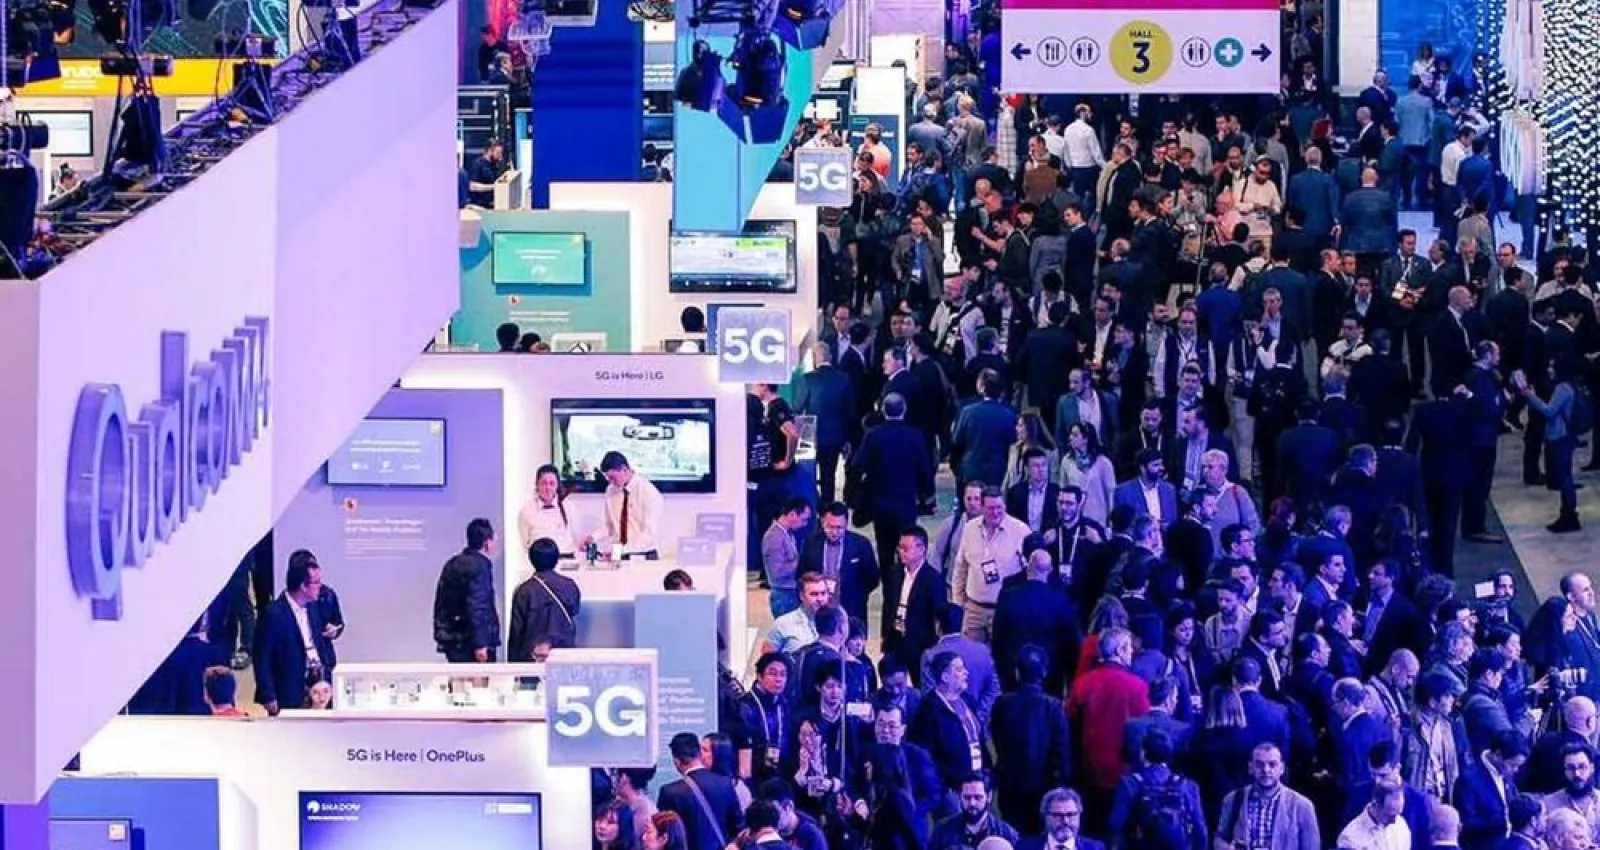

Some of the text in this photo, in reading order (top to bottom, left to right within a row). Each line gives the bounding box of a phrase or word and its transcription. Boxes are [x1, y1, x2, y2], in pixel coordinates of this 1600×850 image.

[1129, 30, 1153, 38] HALL
[1132, 42, 1151, 73] 3
[799, 162, 848, 191] 5G
[723, 327, 785, 364] 5G
[595, 370, 610, 380] 5G
[621, 371, 644, 380] Here
[649, 371, 664, 380] LG
[65, 314, 270, 621] Qualcomm
[554, 685, 646, 737] 5G
[347, 749, 368, 761] 5G
[371, 749, 382, 761] is
[384, 749, 418, 762] Here
[426, 749, 486, 762] OnePlus
